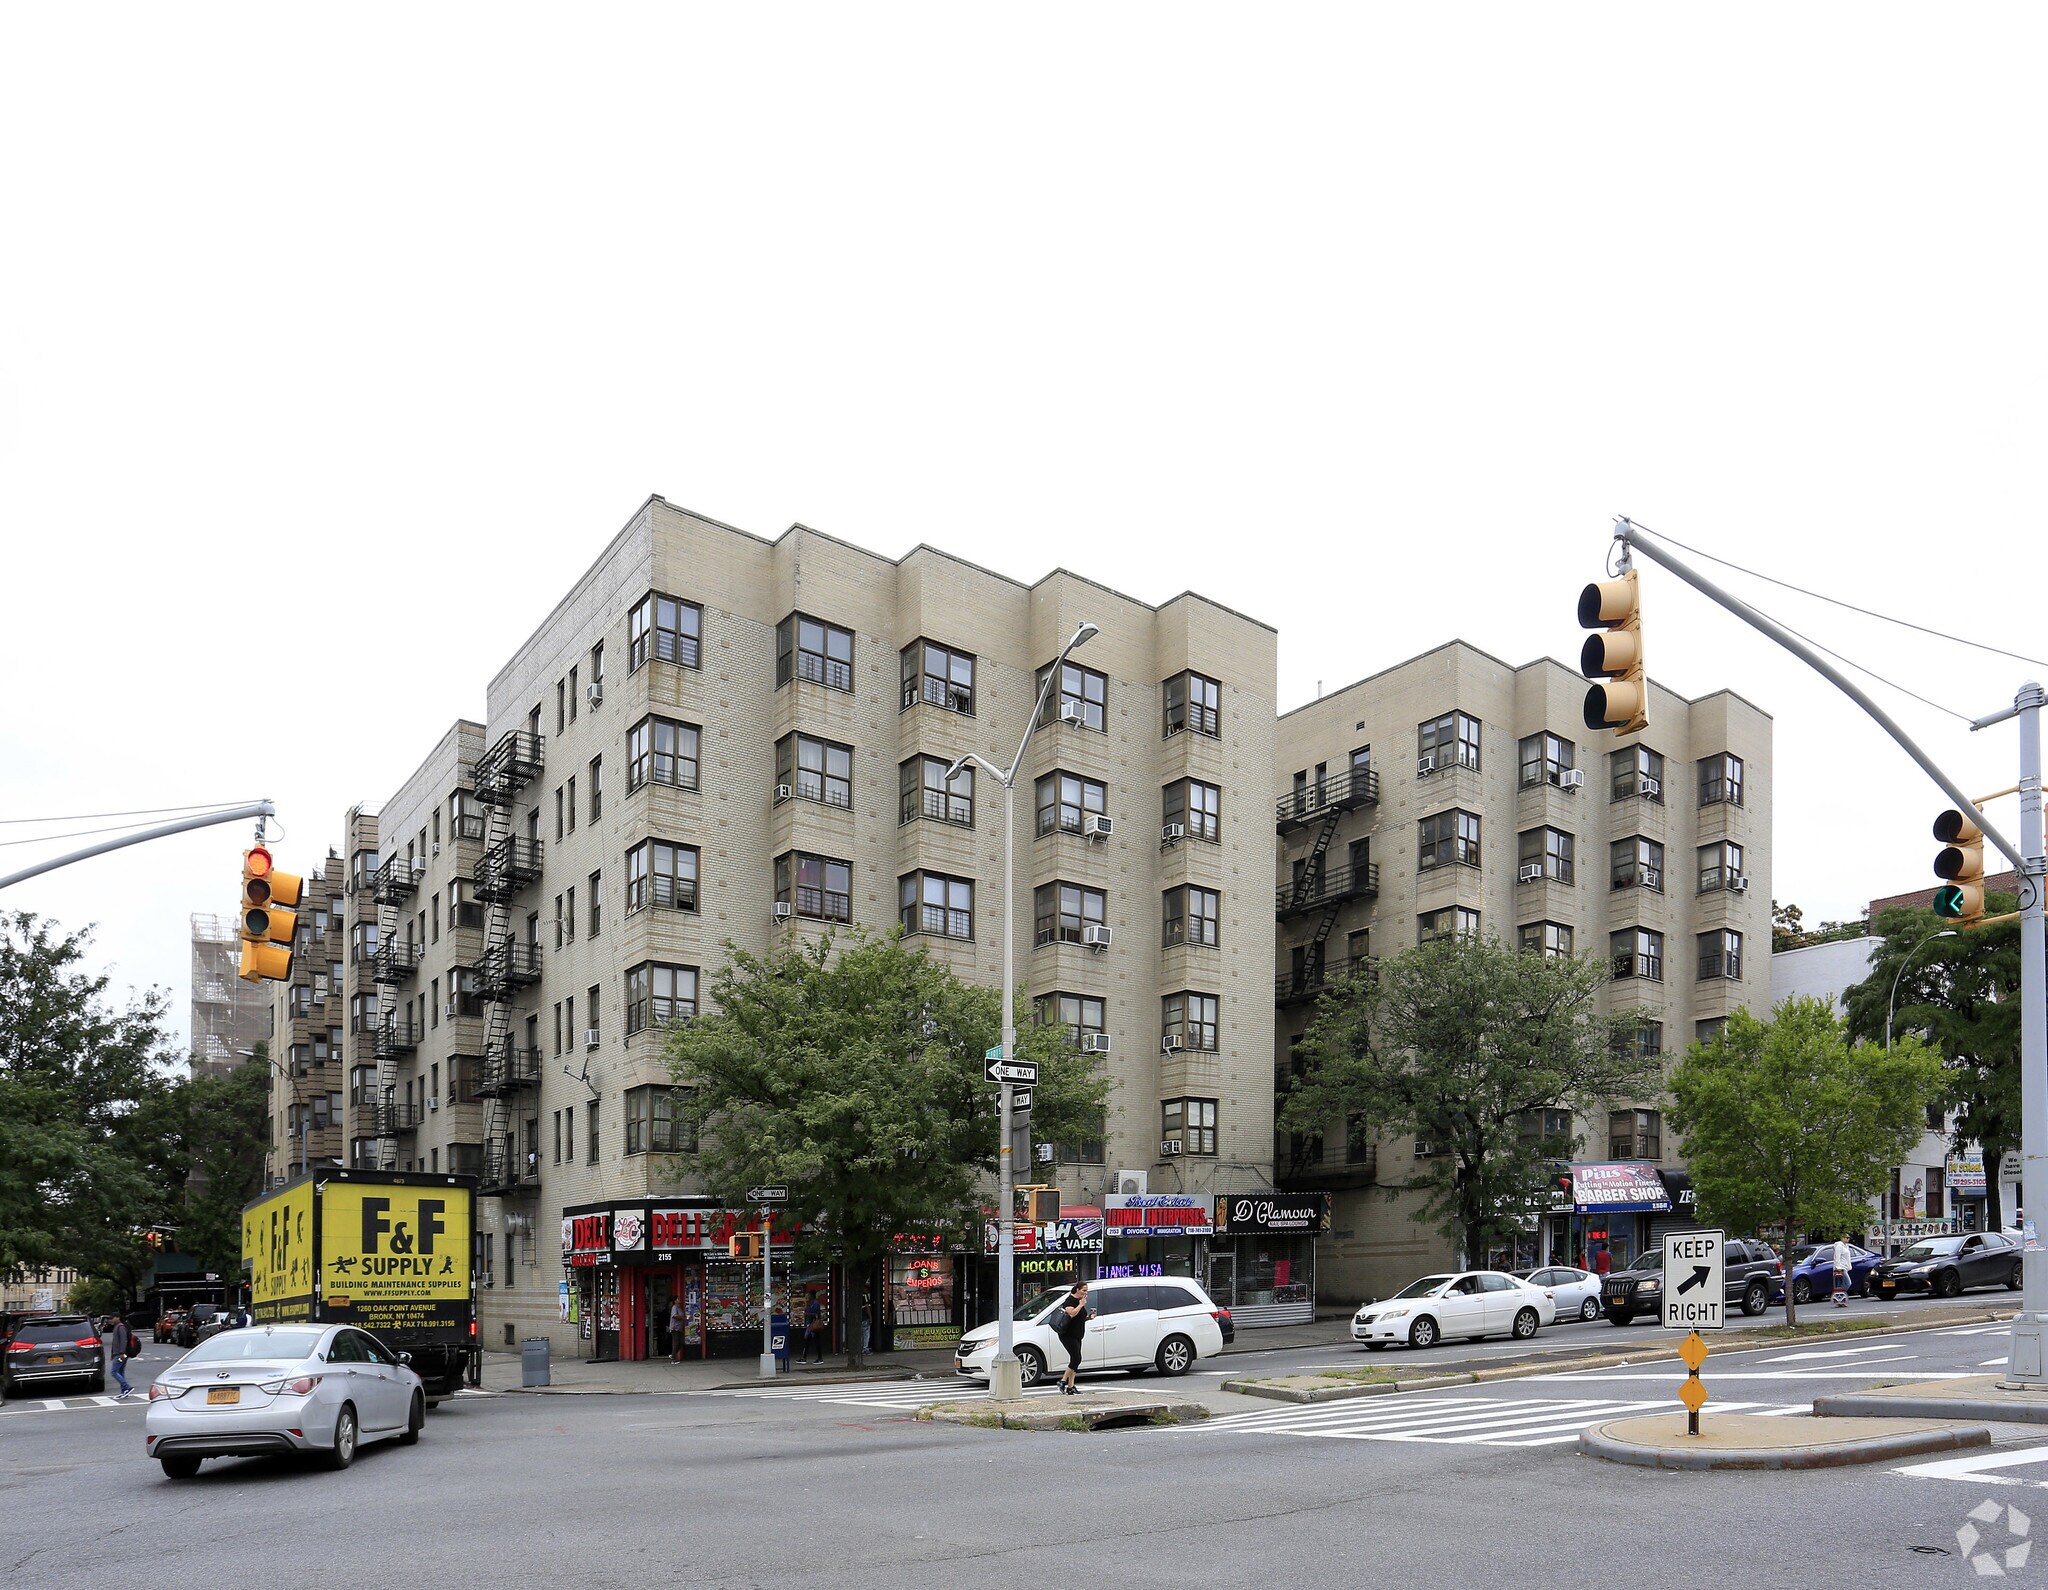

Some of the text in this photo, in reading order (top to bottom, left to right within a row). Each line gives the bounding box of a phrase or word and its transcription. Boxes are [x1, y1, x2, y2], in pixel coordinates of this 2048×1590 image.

[995, 1066, 1032, 1078] ONE WAY
[1017, 1095, 1028, 1105] WAY
[1578, 1188, 1628, 1202] BARBER
[1630, 1187, 1664, 1201] SHOP
[1106, 1208, 1142, 1226] LEDWIN
[1145, 1207, 1206, 1226] ENTERPRISES
[1233, 1200, 1316, 1224] D'Glamour
[574, 1216, 607, 1249] DELI
[651, 1212, 702, 1246] DELI
[1066, 1239, 1102, 1249] VAPES
[1673, 1240, 1714, 1258] KEEP
[658, 1253, 672, 1261] 2155
[361, 1257, 433, 1276] SUPPLY
[909, 1260, 939, 1270] LOANS
[1139, 1264, 1162, 1277] VISA
[330, 1280, 462, 1288] BUILDING MAINTENANCE SUPPLIES
[363, 1289, 431, 1297] WWW.FFSUPPLY.COM
[1669, 1303, 1718, 1320] RIGHT
